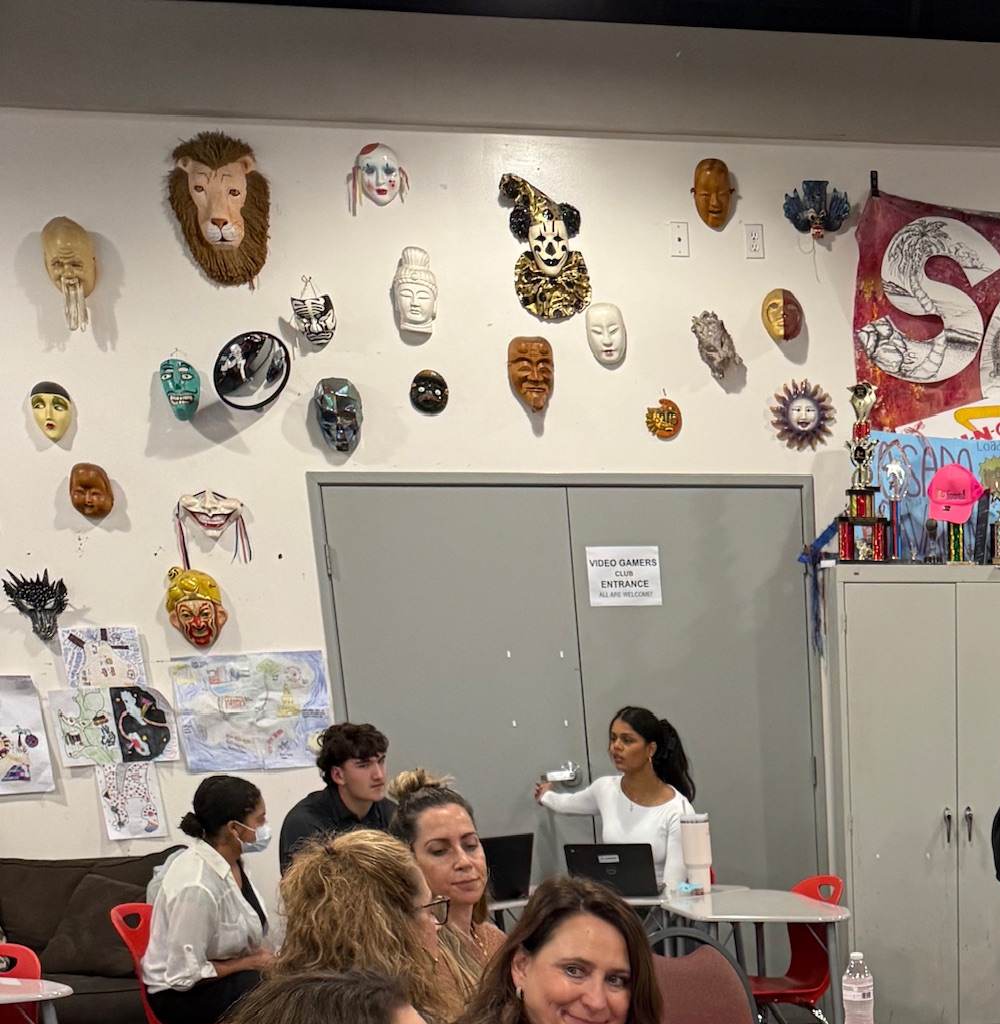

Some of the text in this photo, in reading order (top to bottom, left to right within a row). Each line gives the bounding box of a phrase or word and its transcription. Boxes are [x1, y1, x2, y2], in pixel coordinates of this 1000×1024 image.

[589, 558, 658, 567] VIDEO GAMERS
[601, 580, 649, 588] ENTRANCE
